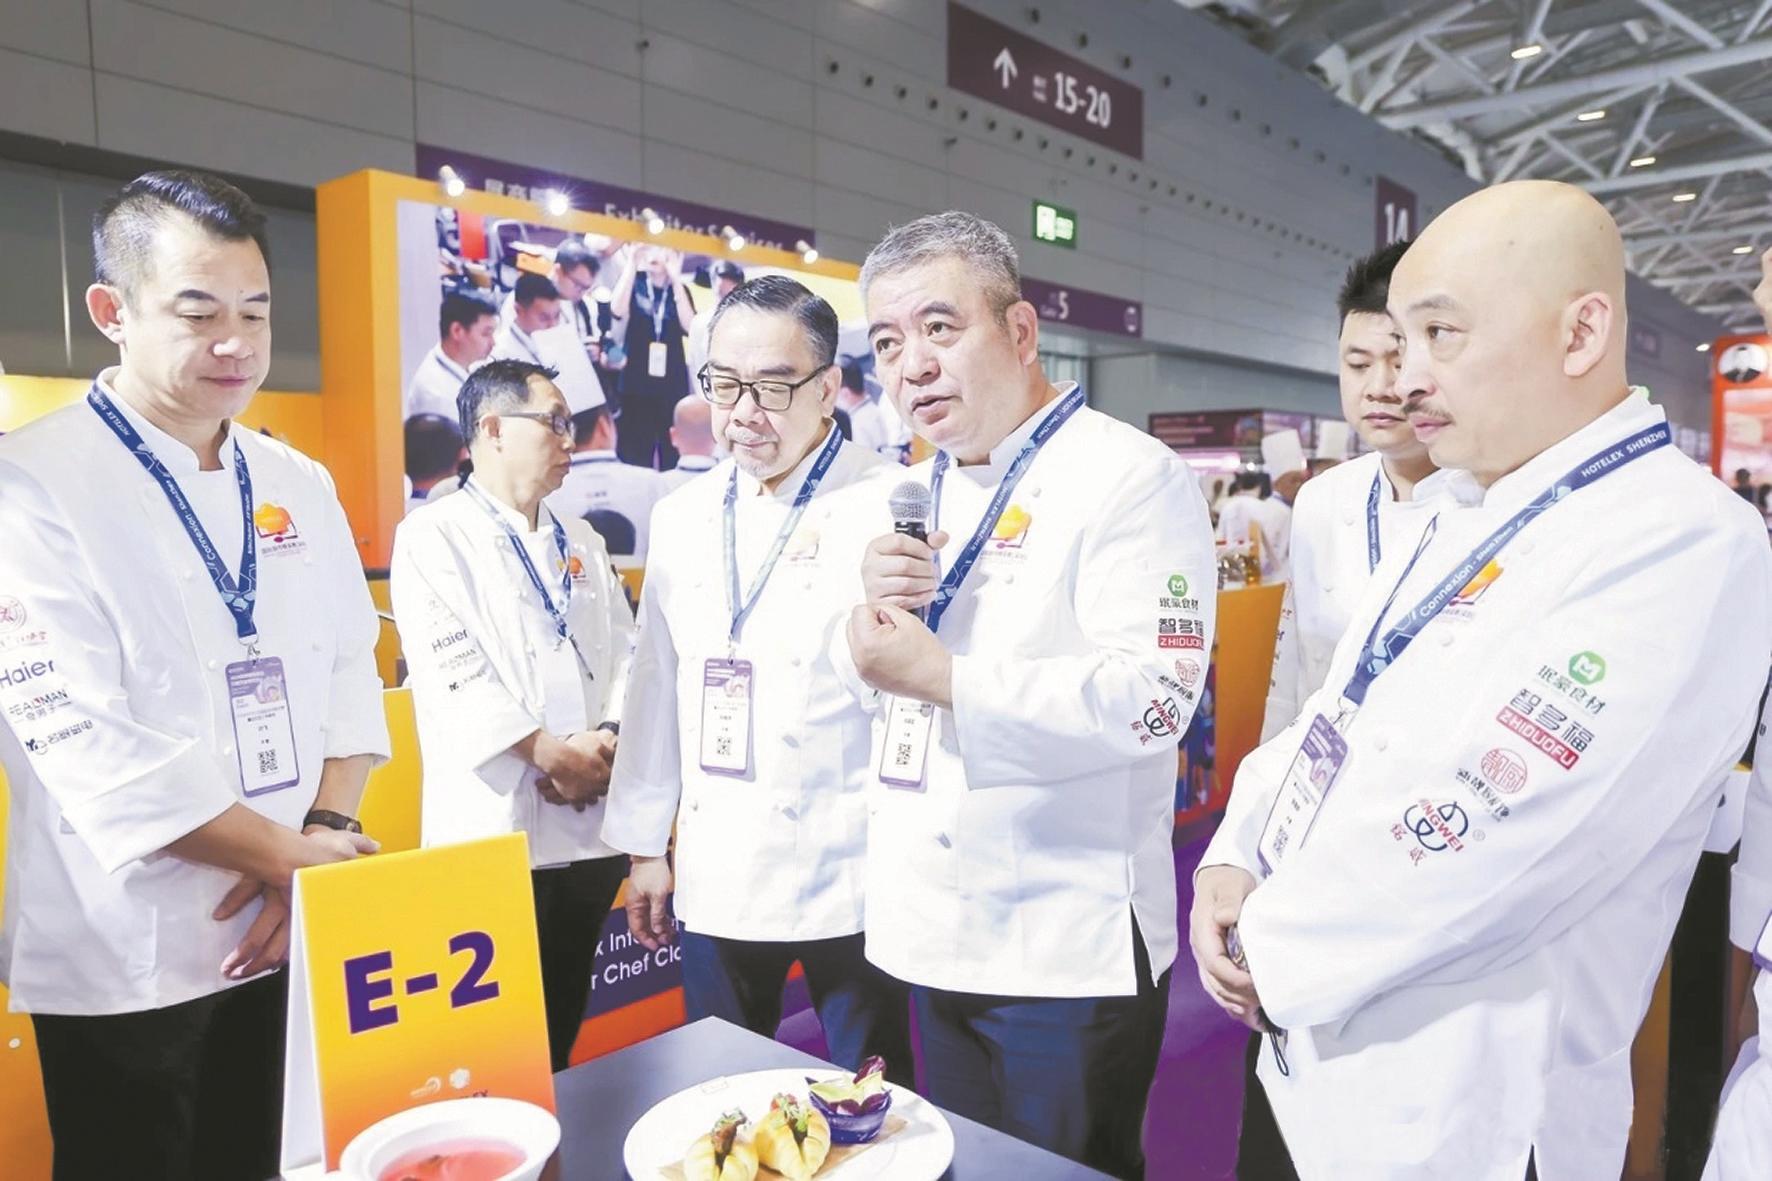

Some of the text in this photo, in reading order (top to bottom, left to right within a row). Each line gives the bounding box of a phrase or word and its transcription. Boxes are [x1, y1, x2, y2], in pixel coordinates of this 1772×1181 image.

[1055, 71, 1111, 129] 15-20
[1059, 290, 1069, 319] 5
[1581, 449, 1625, 478] HOTELEX
[184, 512, 216, 561] Connexion
[1419, 563, 1474, 617] Connexion
[431, 628, 470, 653] Haier
[1151, 698, 1179, 736] MINGWEI
[1498, 708, 1578, 766] ZHIDUOFU
[1509, 688, 1595, 753] 智多福
[344, 931, 500, 1035] E-2
[603, 952, 650, 984] Chef
